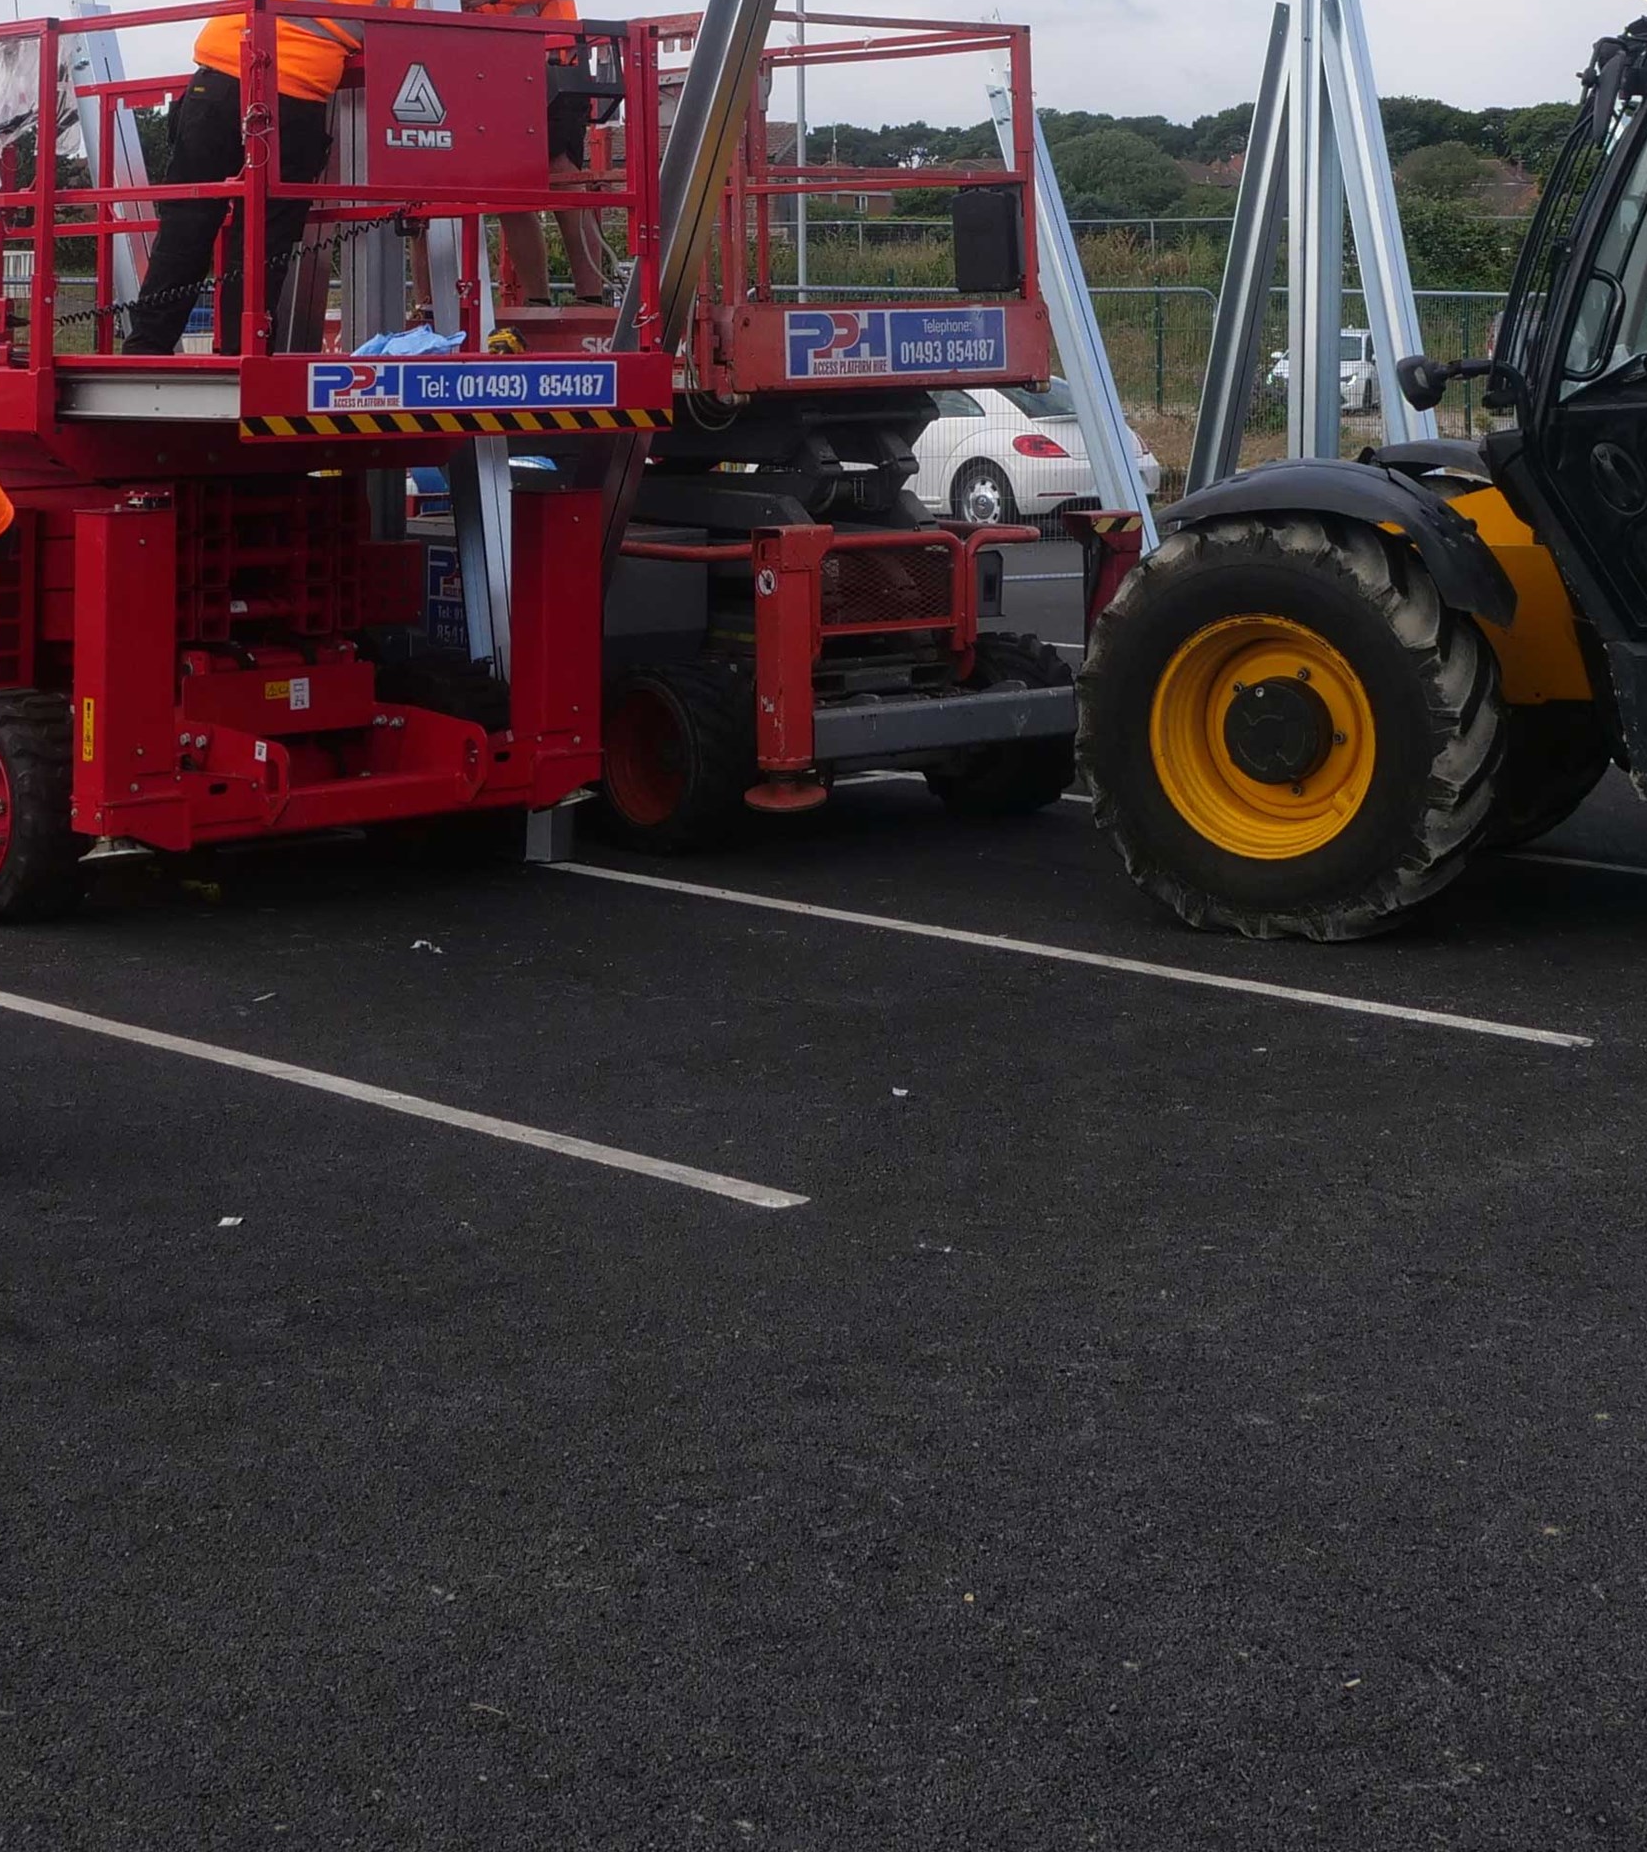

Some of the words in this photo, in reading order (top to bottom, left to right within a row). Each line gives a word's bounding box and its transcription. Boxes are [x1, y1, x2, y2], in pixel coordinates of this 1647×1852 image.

[922, 317, 973, 336] Telephone:
[789, 312, 887, 375] PPH
[900, 341, 942, 364] 01493
[947, 339, 995, 362] 854187
[813, 360, 838, 375] ACCESS
[839, 358, 872, 374] PLATFORM
[872, 358, 887, 373] HIRE
[314, 365, 399, 408] PPH
[417, 374, 449, 398] Tel:
[456, 374, 528, 401] (01493)
[539, 374, 604, 397] 854187
